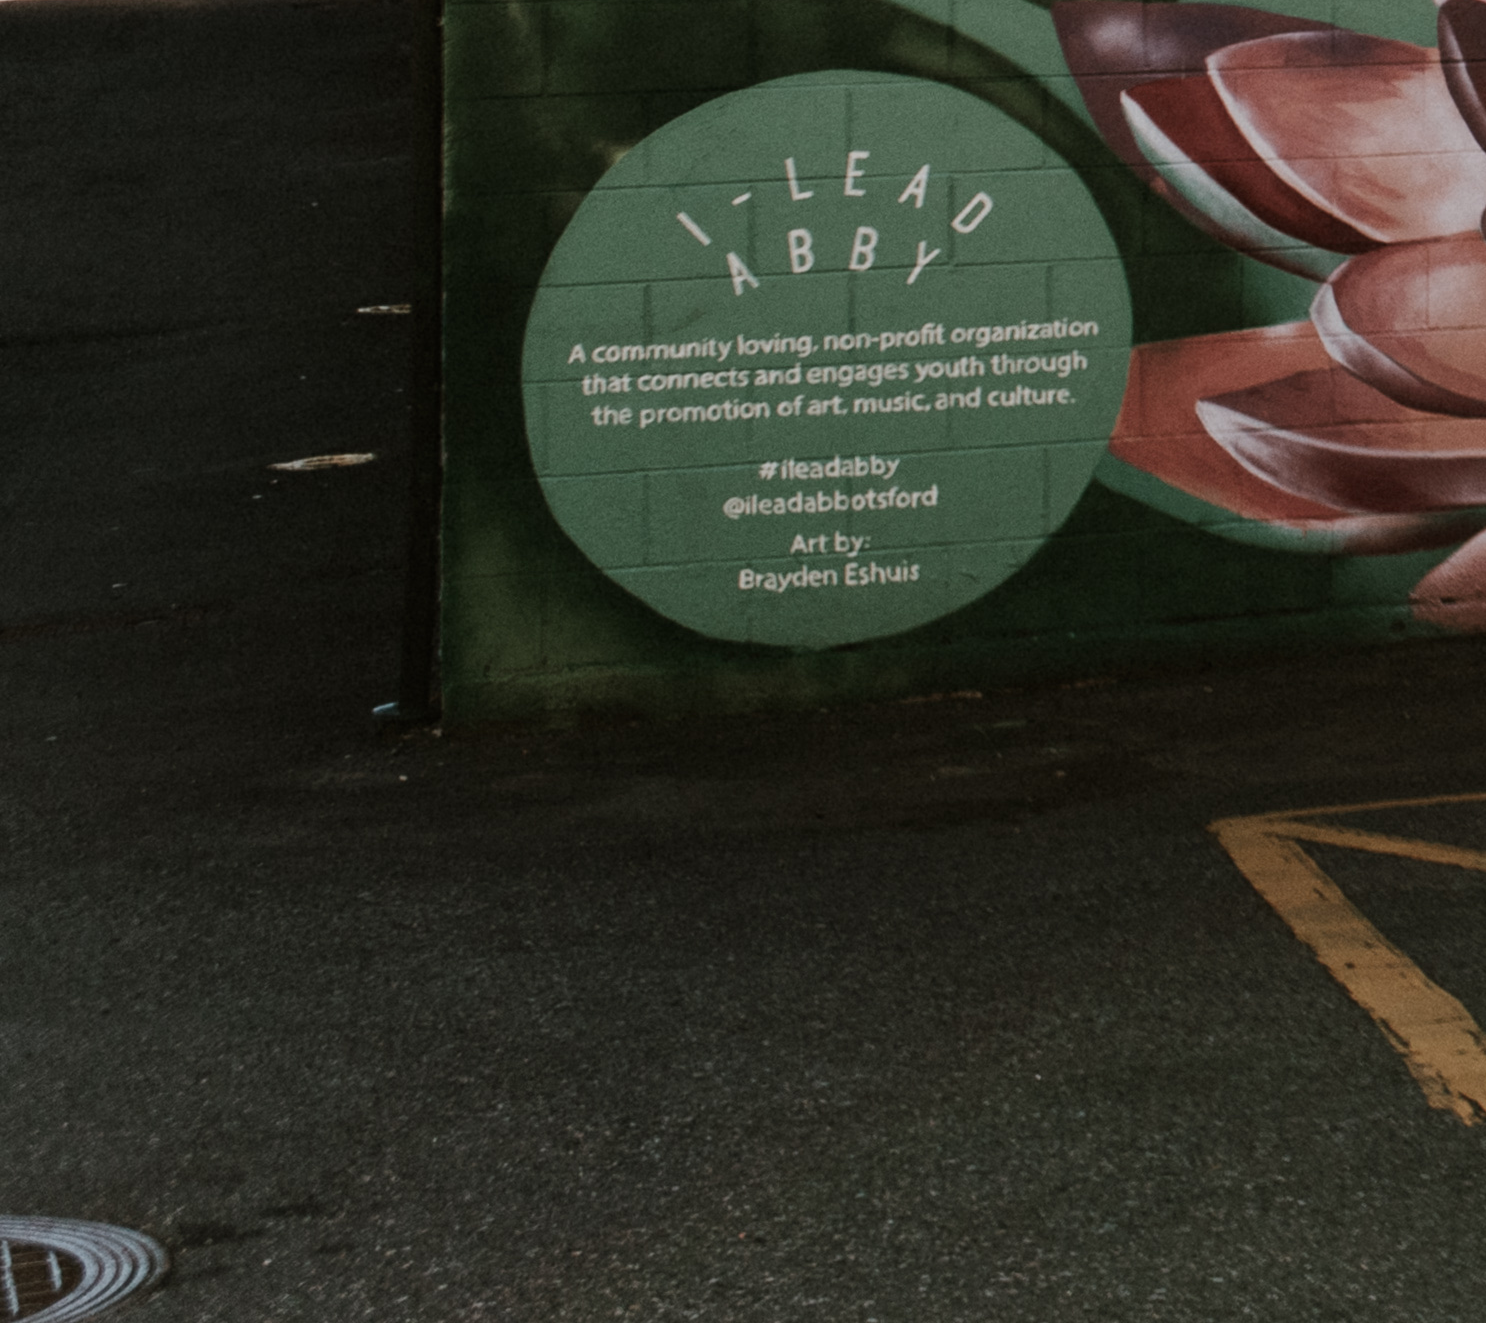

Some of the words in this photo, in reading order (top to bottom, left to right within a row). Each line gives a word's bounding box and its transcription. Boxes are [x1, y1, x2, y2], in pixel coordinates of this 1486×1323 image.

[727, 226, 941, 296] ABBY
[567, 343, 586, 364] A
[591, 337, 732, 363] community
[823, 322, 947, 352] non-profit
[950, 318, 1099, 347] organization
[582, 372, 632, 396] that
[637, 367, 749, 392] connects
[754, 362, 801, 386] and
[806, 362, 909, 387] engages
[914, 356, 985, 384] youth
[990, 350, 1088, 378] through
[591, 405, 633, 426] the
[639, 399, 770, 429] promotion
[776, 395, 804, 417] of
[807, 395, 847, 417] art,
[853, 391, 931, 415] music,
[934, 386, 981, 410] and
[986, 384, 1075, 407] culture.
[758, 455, 900, 481] #ileadabby
[722, 484, 939, 520] @ileadabbotsford
[790, 534, 828, 554] Art
[834, 531, 871, 557] by:
[738, 565, 838, 593] Brayden
[844, 560, 919, 587] Eshuis
